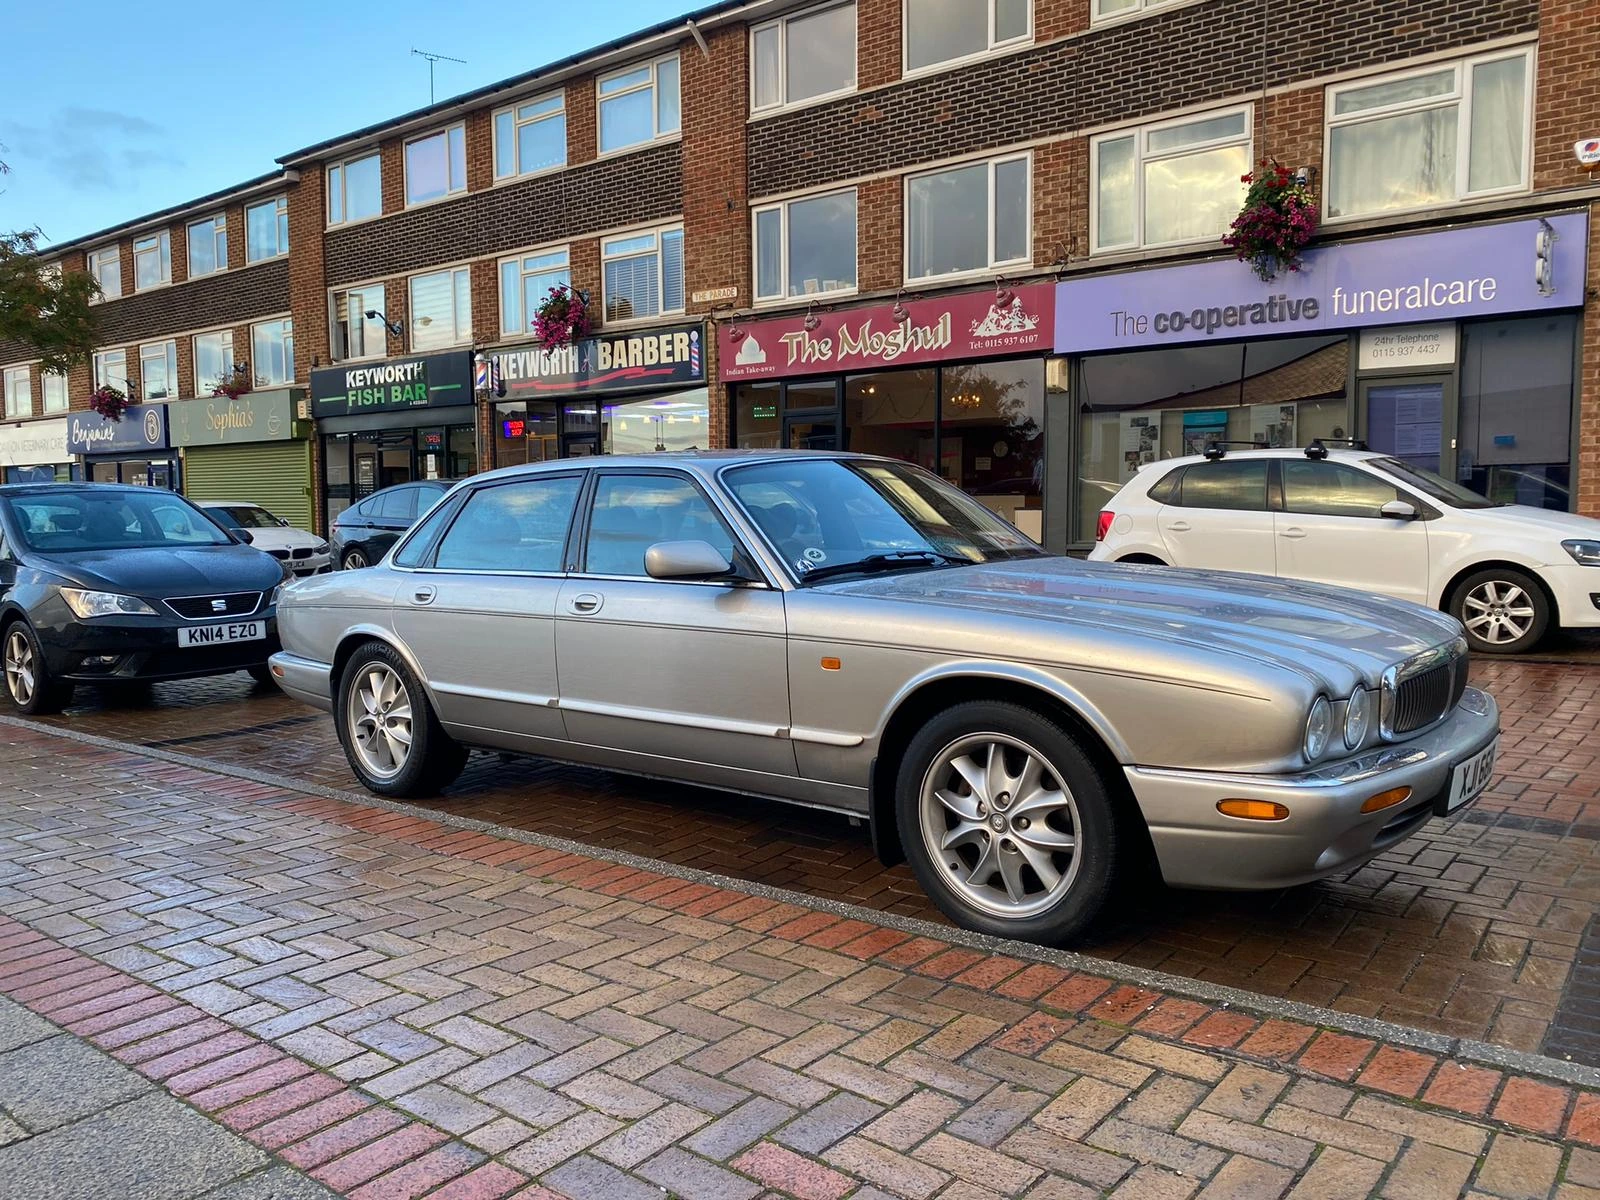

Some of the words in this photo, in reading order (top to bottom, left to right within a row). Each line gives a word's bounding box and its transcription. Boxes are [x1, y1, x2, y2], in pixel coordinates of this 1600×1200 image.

[694, 292, 708, 300] THE
[710, 287, 736, 299] PARADE
[1110, 311, 1147, 336] The
[1154, 294, 1320, 335] co-operative
[1332, 277, 1497, 316] funeralcare
[778, 331, 832, 367] The
[968, 341, 983, 350] Tel:
[985, 338, 1002, 348] 0115
[1004, 336, 1018, 345] 937
[1019, 334, 1039, 344] 6107
[1374, 335, 1394, 346] 24hr
[1396, 333, 1439, 345] Telephone
[500, 345, 579, 380] KEYWORTH
[597, 332, 690, 370] BARBER
[1372, 348, 1395, 358] 0115
[1397, 346, 1414, 357] 937
[1416, 344, 1441, 355] 4437
[346, 361, 425, 388] KEYWORTH
[726, 368, 744, 376] Indian
[348, 388, 385, 407] FISH
[391, 383, 427, 403] BAR
[206, 400, 254, 440] Sophia's
[188, 626, 224, 643] KN14
[228, 623, 257, 639] EZO
